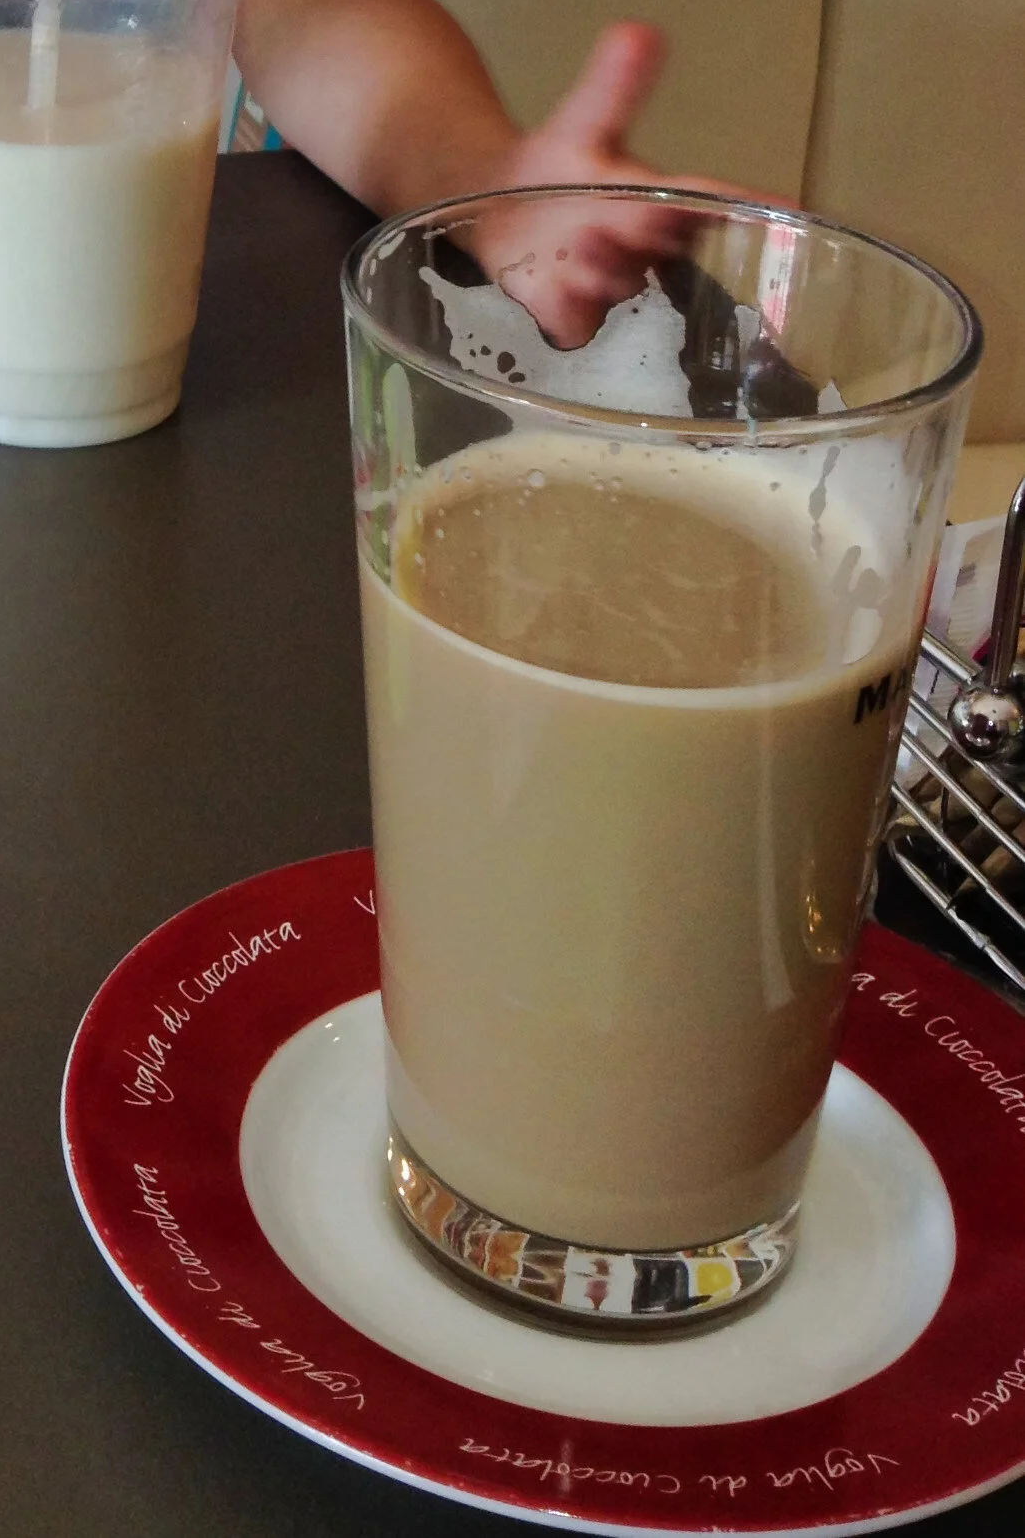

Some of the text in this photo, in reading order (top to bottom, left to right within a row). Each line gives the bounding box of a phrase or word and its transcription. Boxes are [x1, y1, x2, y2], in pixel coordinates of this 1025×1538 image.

[878, 988, 918, 1018] di
[153, 1004, 192, 1035] di
[218, 1300, 262, 1329] di
[459, 1437, 901, 1498] Voglia di Cioccolata
